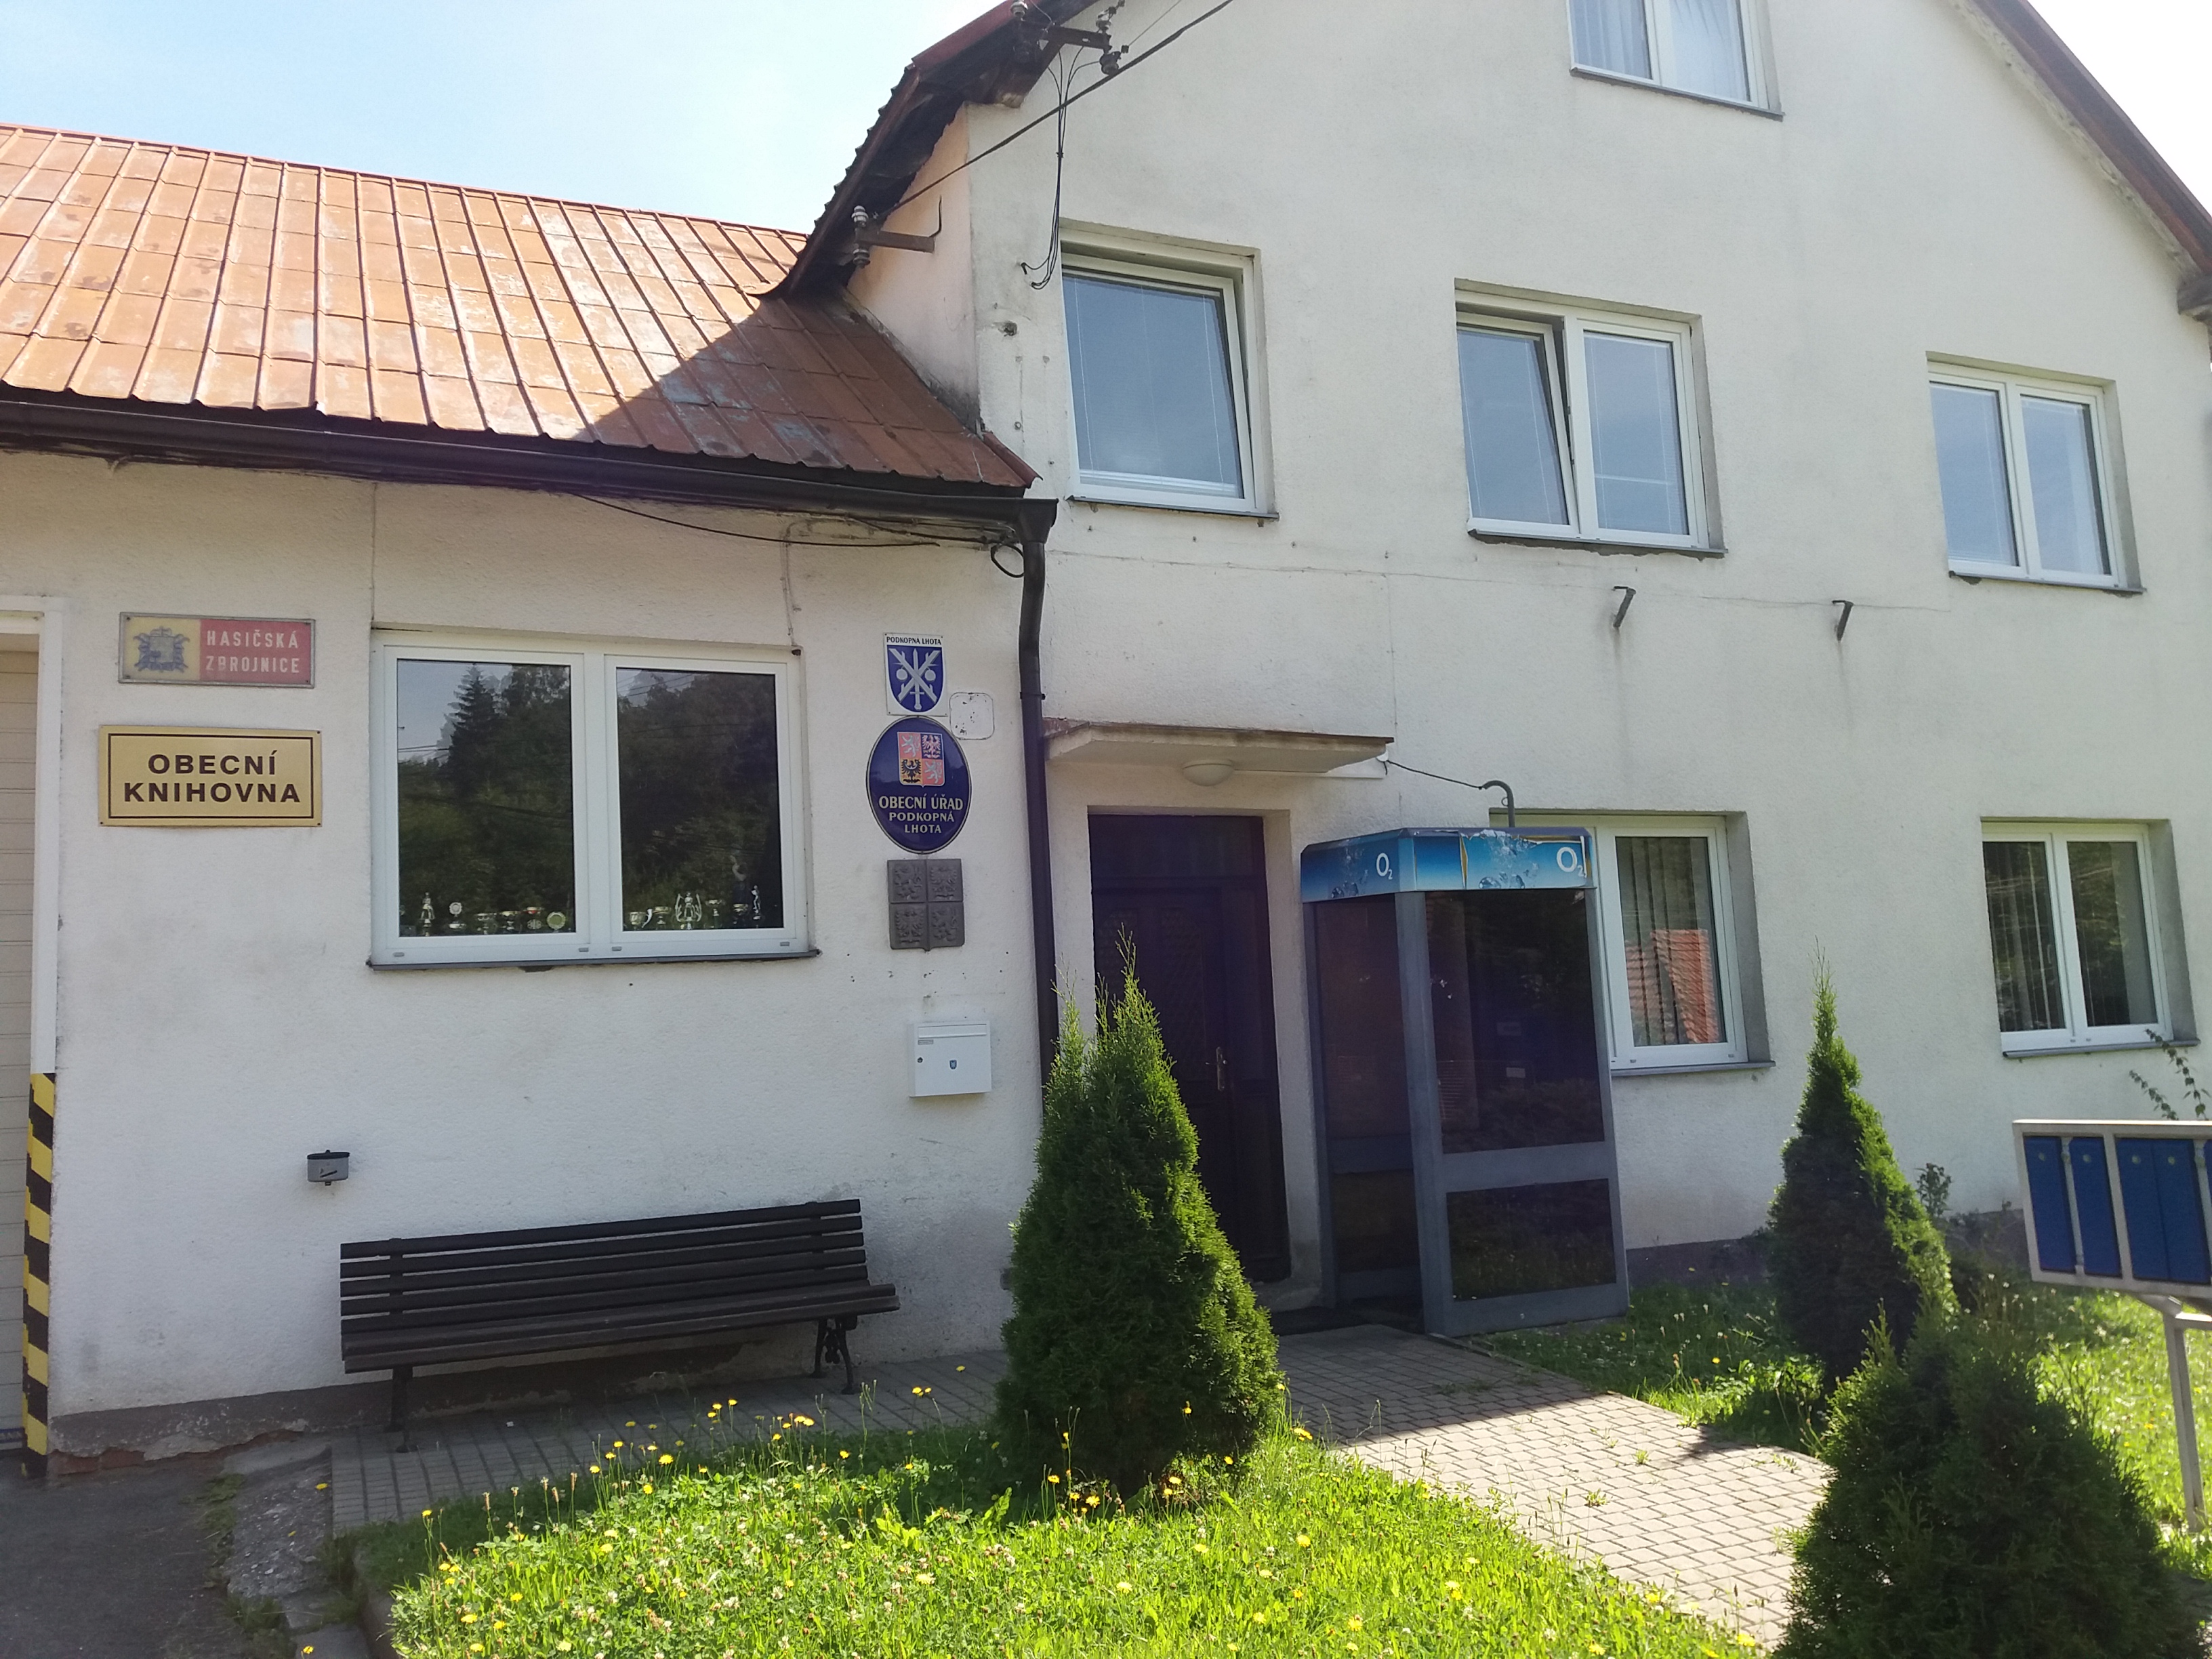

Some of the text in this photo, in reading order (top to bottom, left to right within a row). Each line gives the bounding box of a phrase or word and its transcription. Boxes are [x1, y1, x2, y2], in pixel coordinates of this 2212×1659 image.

[207, 629, 298, 649] HASIČSKÁ
[205, 655, 300, 673] ZBROJNICE
[148, 750, 277, 775] OBECNÍ
[124, 782, 300, 802] KNIHOVNA
[878, 793, 963, 811] OBECNÍ ÚŘAD
[888, 811, 955, 822] PODKOPNÁ
[904, 824, 941, 834] LHOTA
